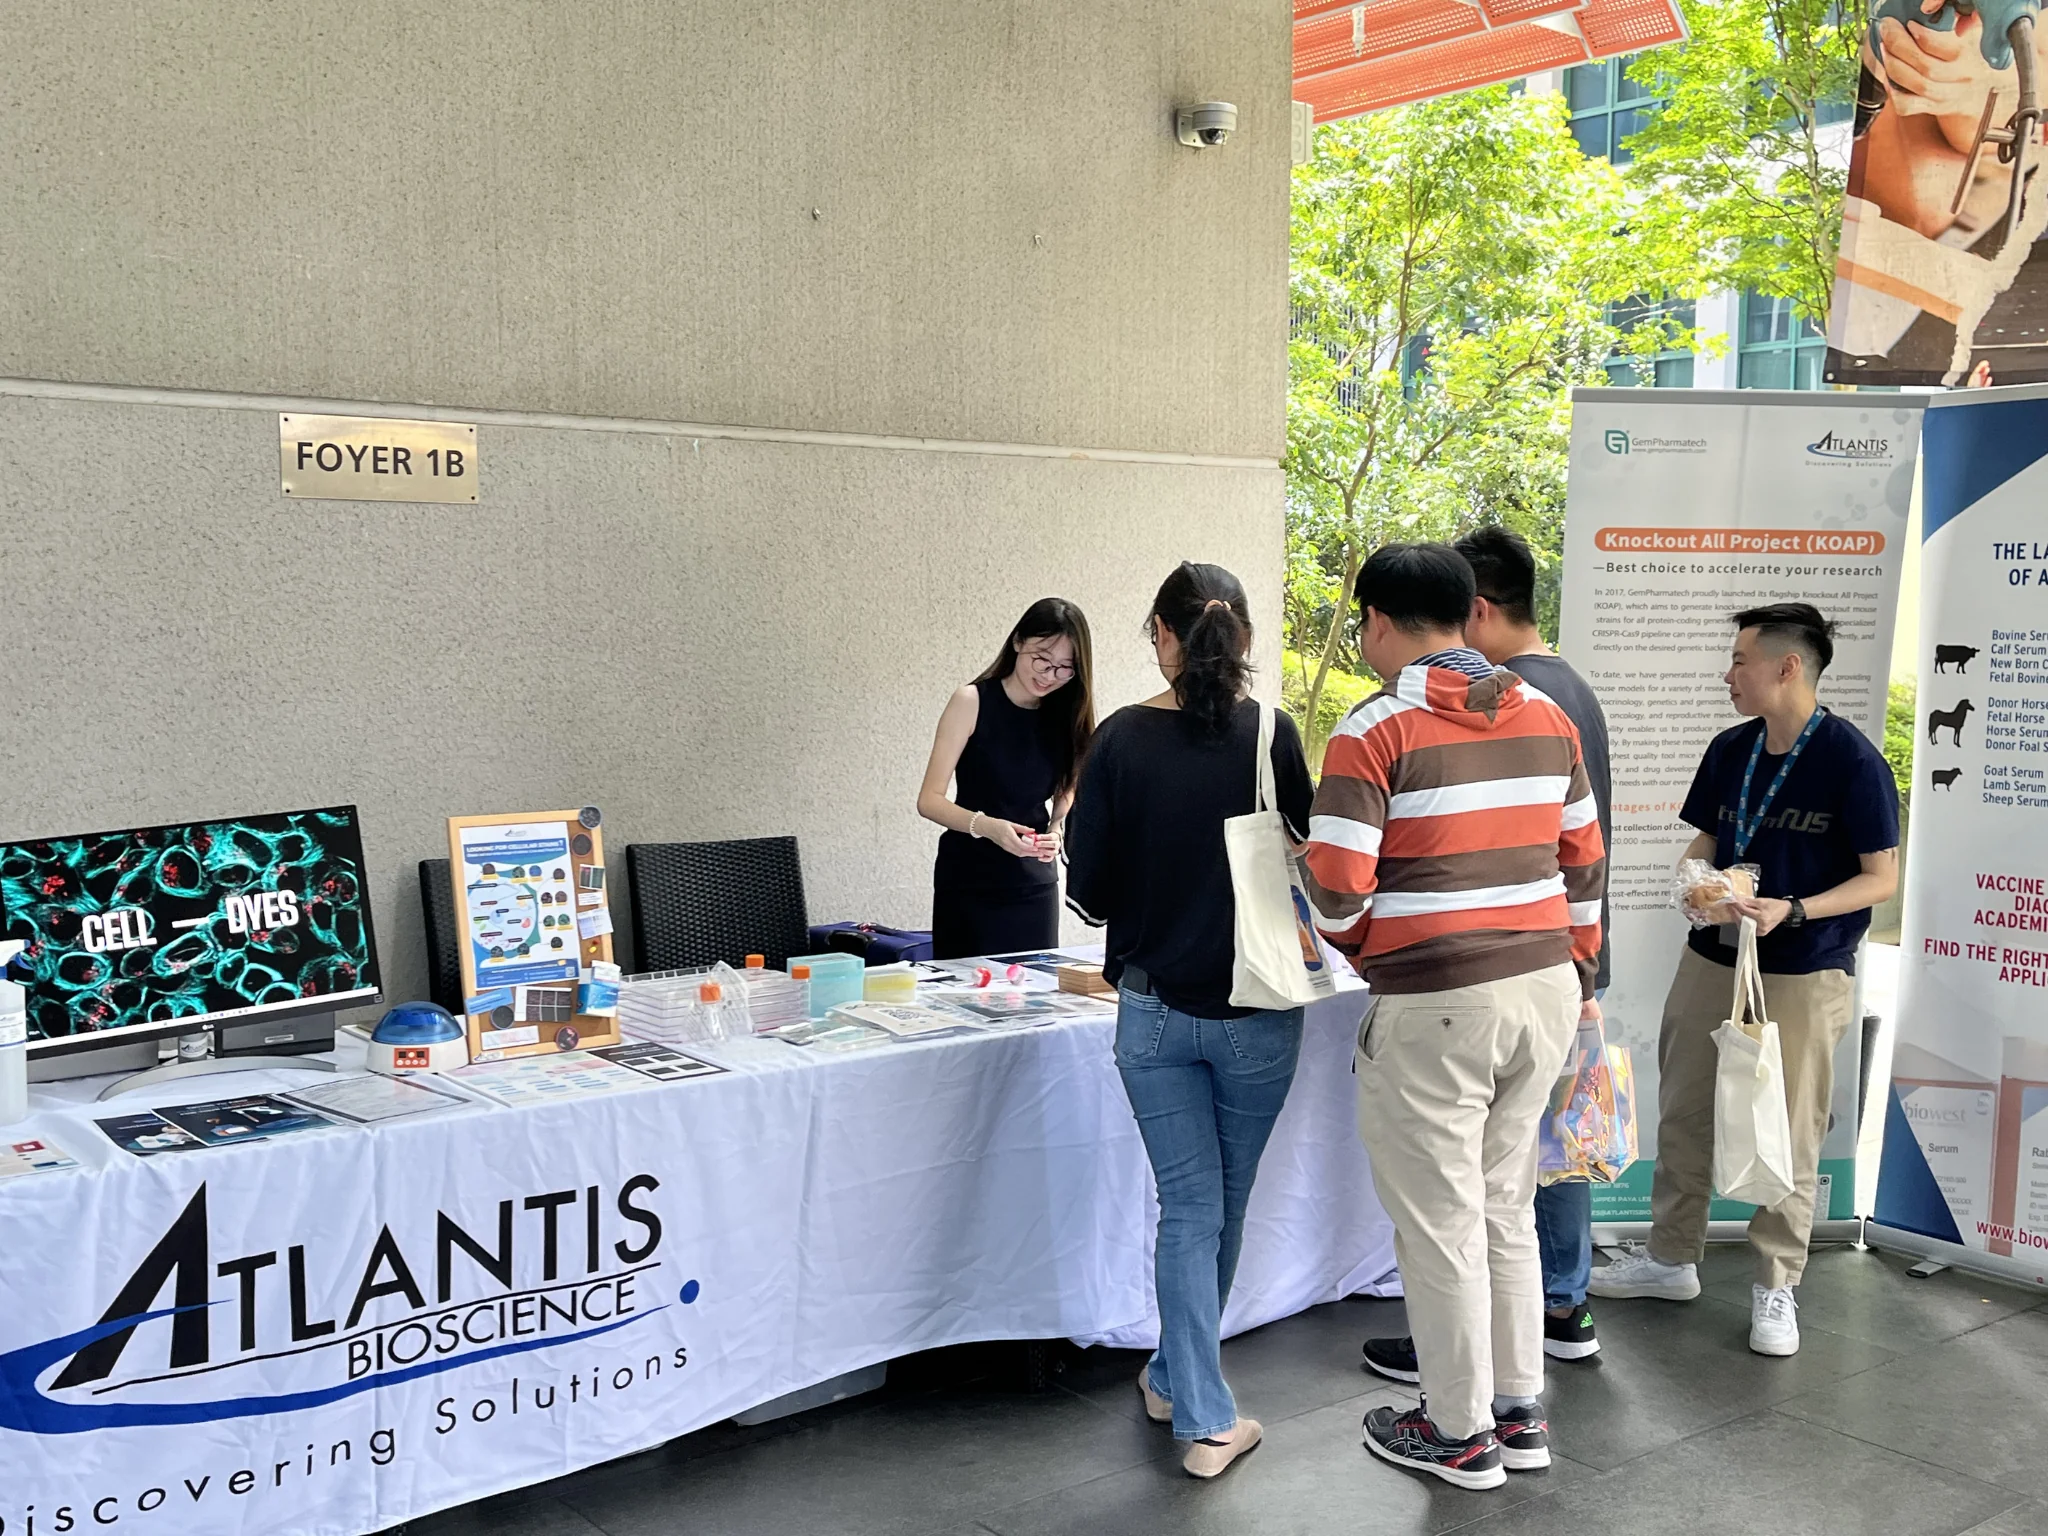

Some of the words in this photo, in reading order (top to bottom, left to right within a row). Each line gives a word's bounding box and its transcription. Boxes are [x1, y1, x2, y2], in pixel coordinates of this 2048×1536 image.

[1631, 437, 1707, 447] GemPharmatech
[1815, 430, 1888, 451] ATLANTIS
[297, 441, 413, 475] FOYER
[426, 449, 465, 477] 1B
[1604, 532, 1697, 549] Knockout
[1700, 533, 1726, 549] All
[1730, 534, 1800, 553] Project
[1806, 535, 1876, 554] (KOAP)
[1993, 543, 2027, 560] THE
[1641, 562, 1686, 574] choice
[1690, 563, 1705, 574] to
[1708, 563, 1781, 575] accelerate
[1785, 566, 1818, 577] your
[1823, 565, 1883, 577] research
[2009, 568, 2032, 586] OF
[1594, 588, 1603, 596] In
[1605, 588, 1626, 597] 2017,
[1628, 589, 1687, 597] GemPharmatech
[1691, 590, 1720, 599] proudly
[1722, 590, 1756, 598] launched
[1769, 590, 1800, 600] flagship
[1802, 591, 1839, 599] Knockout
[1853, 592, 1878, 601] Project
[1594, 602, 1623, 611] (KOAP),
[1681, 604, 1713, 612] generate
[1596, 616, 1621, 624] strains
[1623, 616, 1635, 624] for
[1636, 616, 1646, 624] all
[1647, 617, 1701, 626] protein-coding
[1592, 629, 1640, 638] CRISPR-Cas9
[1641, 629, 1671, 639] pipeline
[1687, 632, 1719, 640] generate
[1992, 629, 2027, 641] Bovine
[1593, 643, 1622, 652] directly
[1635, 643, 1648, 651] the
[1649, 643, 1676, 651] desired
[1677, 644, 1704, 653] genetic
[1705, 644, 1734, 653] backgro
[1991, 643, 2011, 655] Calf
[2014, 643, 2047, 655] Serum
[1990, 657, 2013, 669] New
[2015, 658, 2040, 669] Born
[1603, 671, 1622, 679] date,
[1660, 672, 1696, 680] generated
[1990, 671, 2015, 683] Fetal
[1599, 699, 1645, 707] docrinology,
[1647, 699, 1677, 707] genetics
[1988, 696, 2019, 708] Donor
[1609, 712, 1645, 721] oncology,
[1666, 712, 1711, 720] reproductive
[1987, 710, 2012, 722] Fetal
[2015, 711, 2045, 724] Horse
[1628, 725, 1656, 733] enables
[1683, 726, 1713, 734] produce
[1986, 724, 2016, 737] Horse
[1622, 740, 1631, 748] By
[1633, 740, 1660, 748] making
[1985, 738, 2016, 751] Donor
[2019, 740, 2040, 752] Foal
[1633, 753, 1659, 761] quality
[1643, 766, 1660, 775] drug
[1983, 764, 2008, 777] Goat
[2011, 766, 2044, 779] Serum
[1983, 778, 2011, 791] Lamb
[2013, 780, 2047, 793] Serum
[1982, 792, 2014, 807] Sheep
[2016, 794, 2048, 808] Serum
[1654, 802, 1667, 811] of
[1623, 823, 1663, 832] collection
[1664, 823, 1673, 831] of
[1609, 863, 1651, 872] urnaround
[1653, 863, 1671, 871] time
[1976, 873, 2045, 895] VACCINE
[1631, 902, 1667, 911] customer
[81, 907, 157, 953] CELL
[225, 888, 300, 935] DYES
[1974, 909, 2048, 933] ACADEMI
[1925, 938, 1960, 958] FIND
[1966, 943, 1997, 963] THE
[1904, 1101, 1967, 1123] biowest
[1928, 1142, 1959, 1154] Serum
[48, 1173, 662, 1391] ATLANTIS
[347, 1276, 636, 1380] BIOSCIENCE
[0, 1427, 397, 1536] iscovering
[434, 1346, 689, 1436] Solutions
